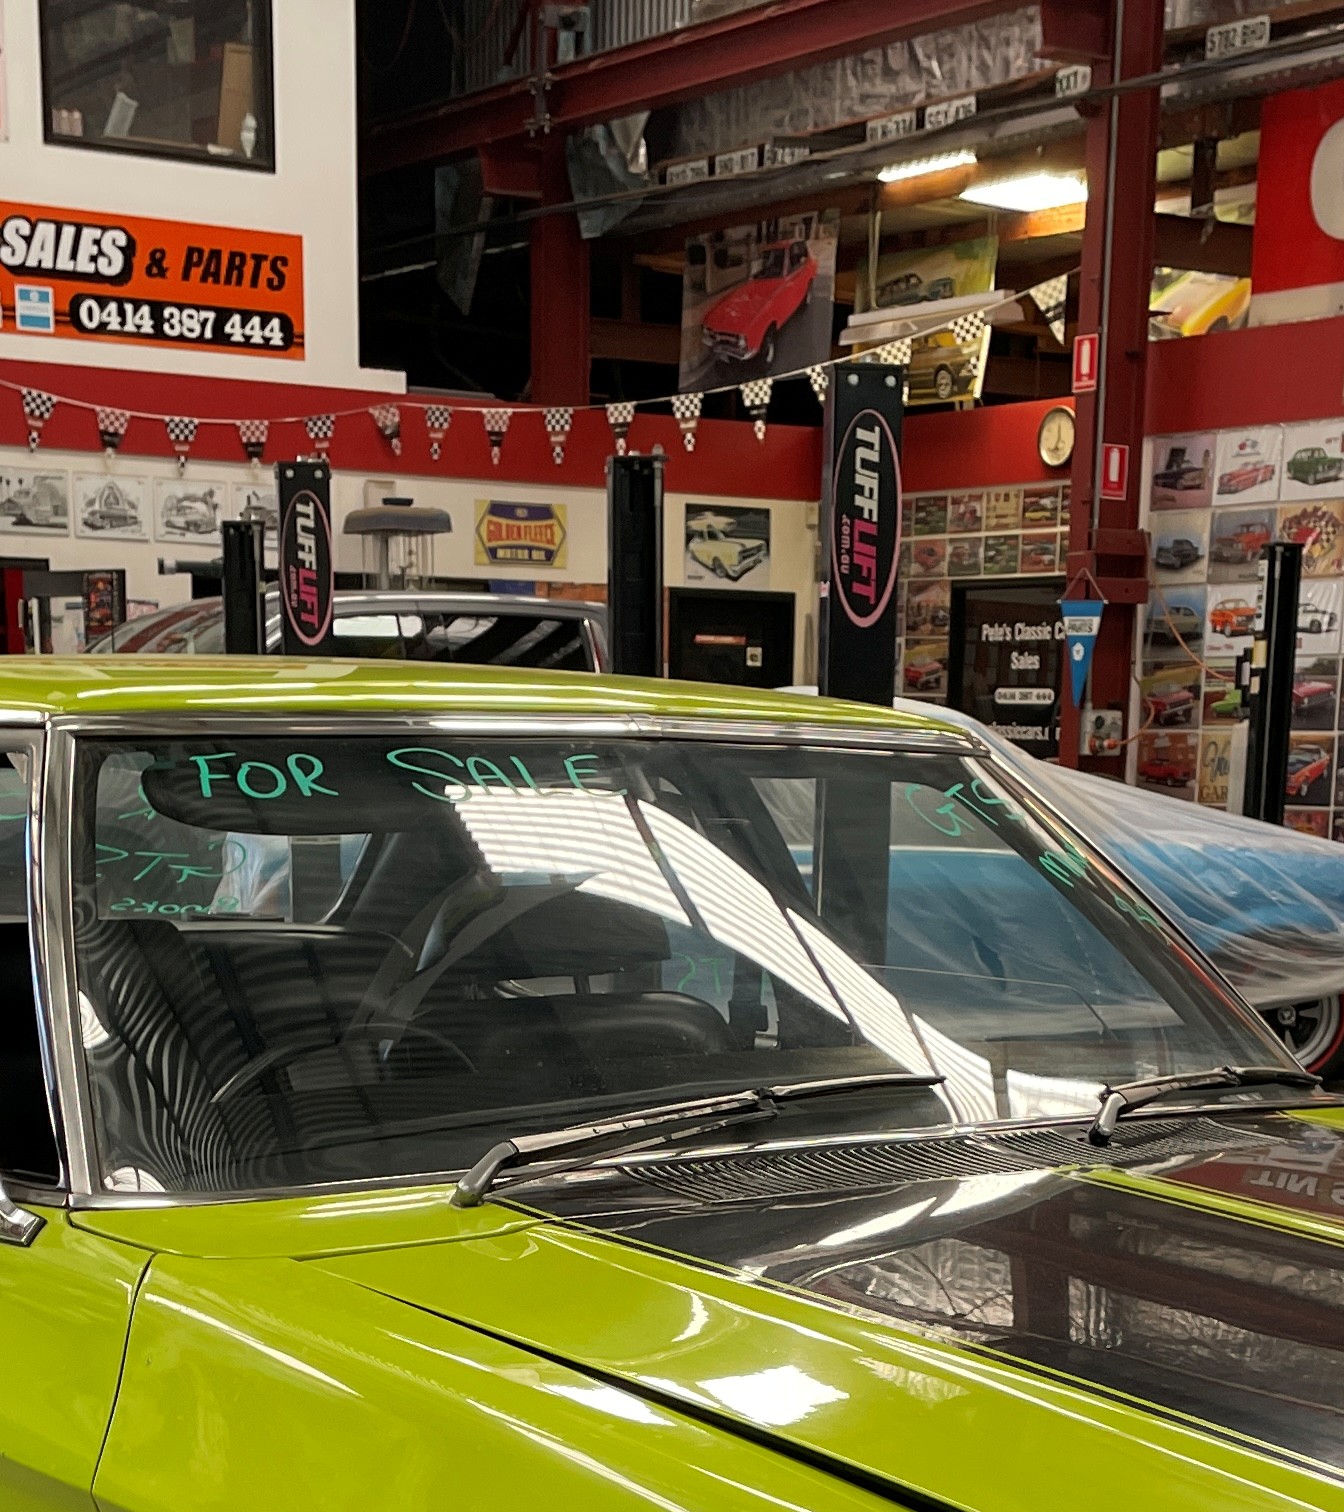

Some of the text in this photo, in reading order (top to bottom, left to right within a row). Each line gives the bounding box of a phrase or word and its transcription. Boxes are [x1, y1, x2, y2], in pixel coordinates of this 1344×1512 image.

[0, 217, 129, 278] SALES
[145, 247, 169, 279] &
[181, 245, 289, 291] PARTS
[79, 299, 285, 347] 0414 387 444
[981, 623, 1012, 642] Pete's
[1014, 621, 1053, 641] Classic
[1010, 651, 1041, 670] Sales
[190, 747, 629, 803] FOR SALE
